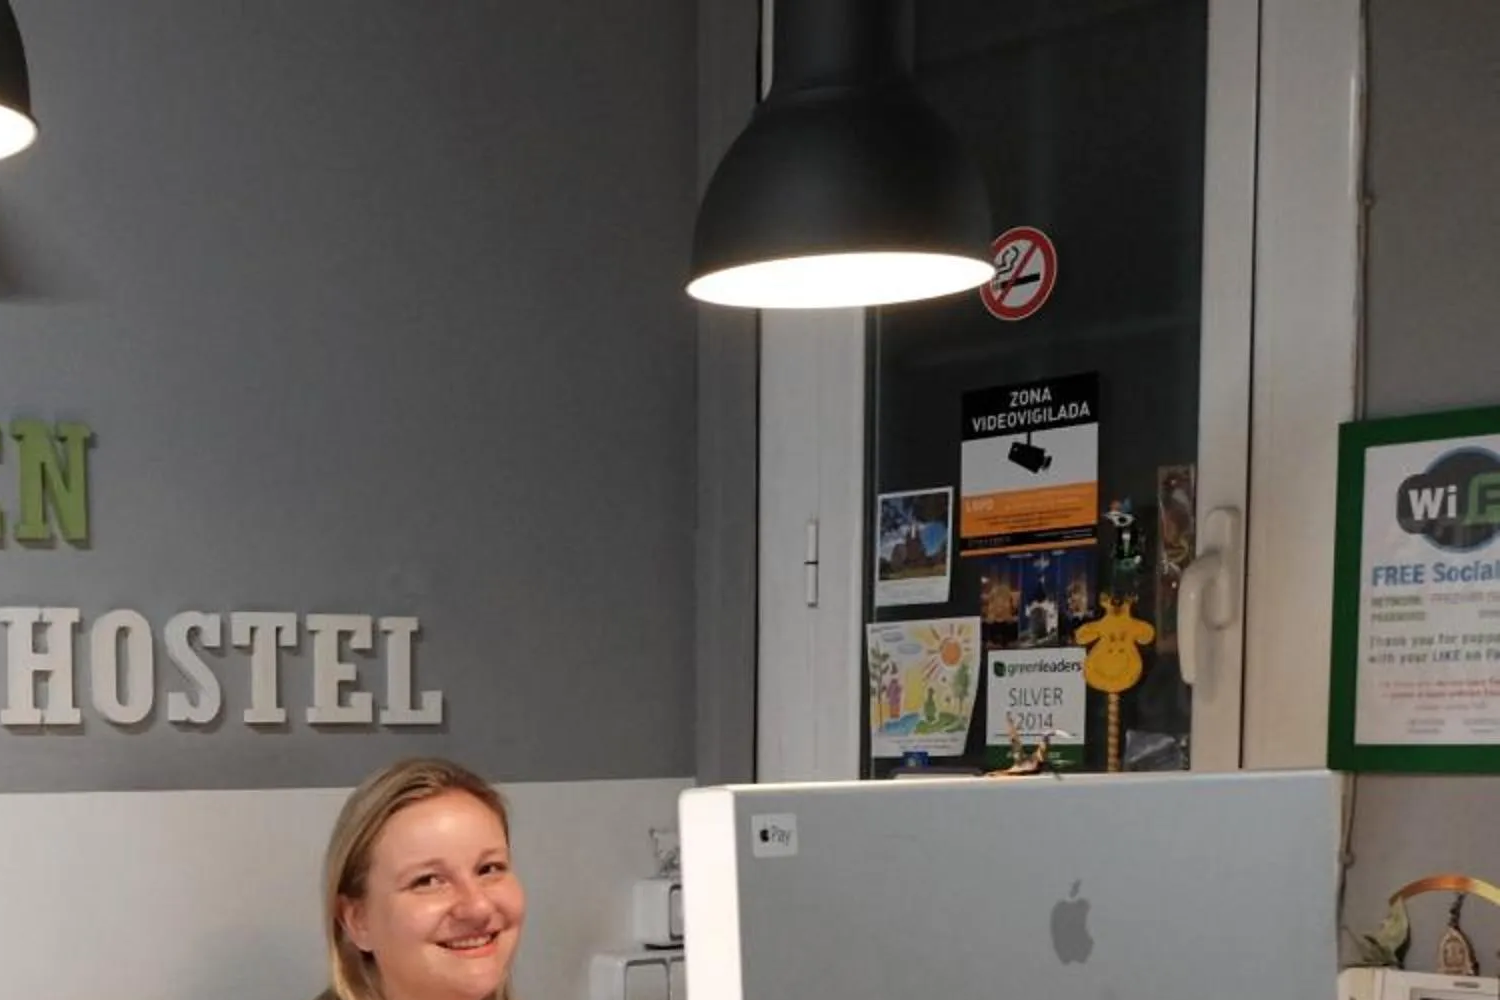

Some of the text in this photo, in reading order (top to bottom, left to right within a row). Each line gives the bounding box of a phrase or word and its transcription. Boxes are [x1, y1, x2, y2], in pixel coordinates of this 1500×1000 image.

[1009, 386, 1052, 407] ZONA
[972, 401, 1090, 432] VIDEOVIGILADA
[1372, 564, 1425, 586] FREE
[1008, 687, 1064, 707] SILVER
[1016, 711, 1053, 730] 2014
